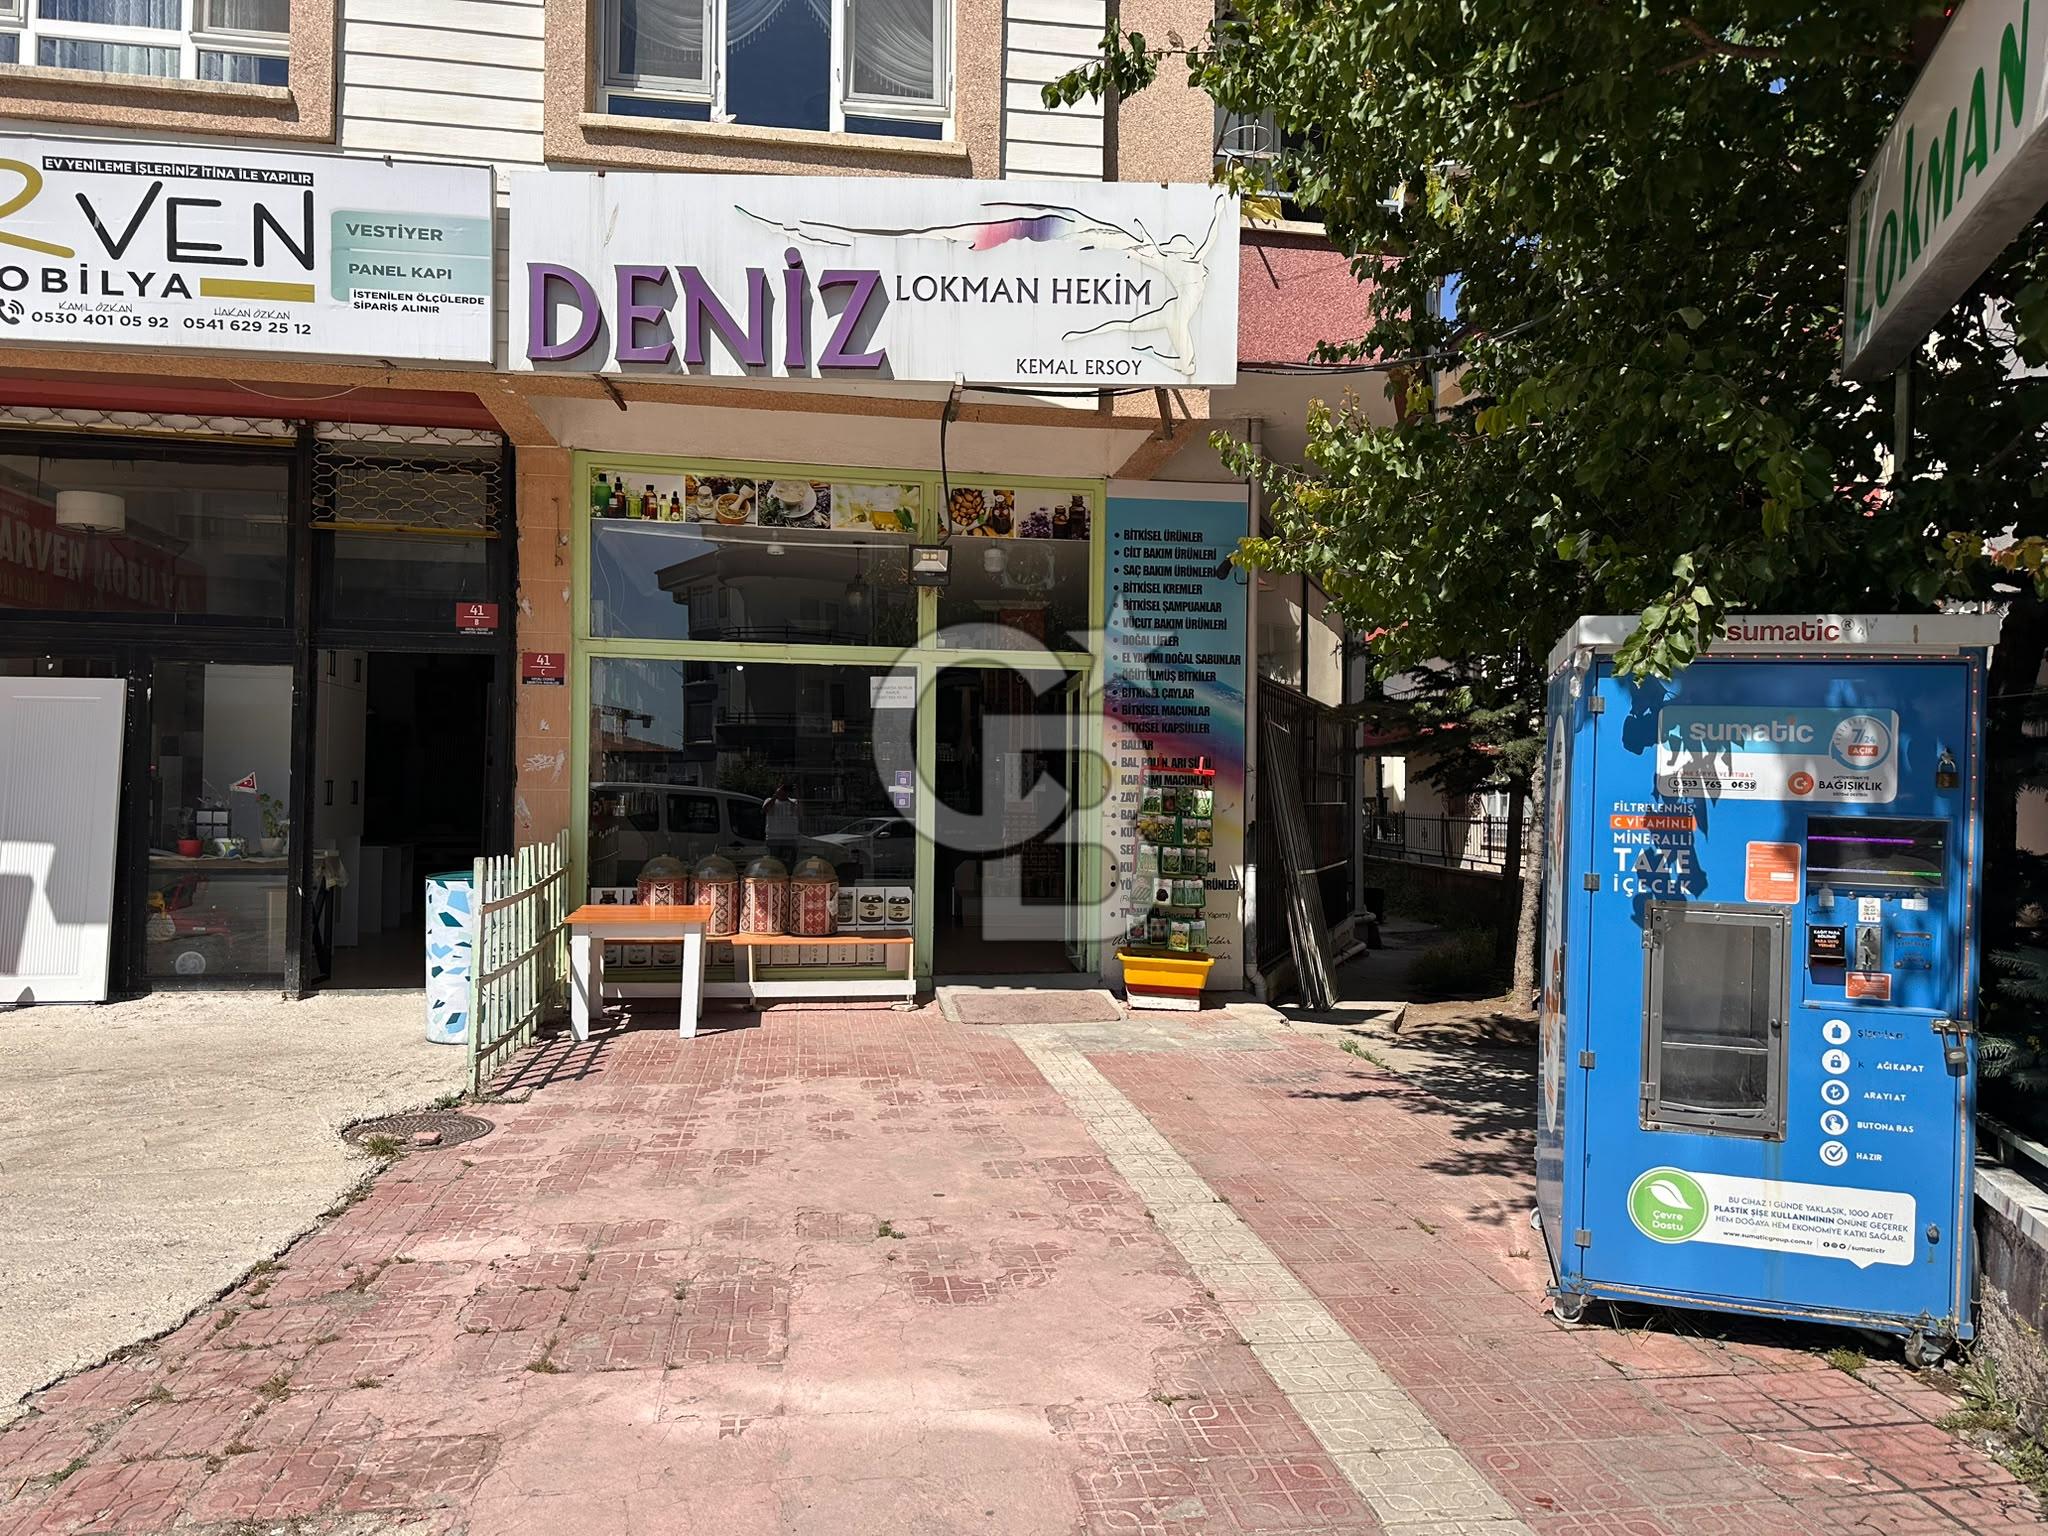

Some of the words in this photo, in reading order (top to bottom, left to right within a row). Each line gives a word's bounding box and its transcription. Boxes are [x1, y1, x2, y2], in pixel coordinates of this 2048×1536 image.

[45, 158, 63, 169] EV
[65, 159, 132, 173] YENİLEME
[135, 161, 198, 177] İŞLERİNİZ
[201, 166, 236, 179] İTİNA
[238, 168, 259, 181] İLE
[261, 171, 312, 184] YAPILIR
[1853, 0, 2030, 341] LOKMAN
[345, 223, 443, 241] VESTİYER
[348, 263, 407, 278] PANEL
[411, 267, 452, 280] KAPI
[896, 274, 1040, 305] LOKMAN
[1052, 271, 1152, 306] HEKİM
[353, 289, 413, 302] İSTENİLEN
[416, 292, 485, 305] ÖLÇÜLERDE
[95, 300, 133, 313] ÖZKAN
[213, 307, 251, 318] HAKAN
[253, 307, 291, 320] ÖZKAN
[353, 300, 398, 313] SİPARİŞ
[401, 303, 440, 314] ALINIR
[526, 247, 888, 373] DENİZ
[32, 311, 77, 324] 0530
[83, 313, 114, 325] 401
[120, 315, 142, 327] 05
[148, 316, 169, 328] 92
[183, 317, 224, 330] 0541
[230, 320, 262, 332] 629
[268, 322, 288, 333] 25
[294, 323, 312, 335] 12
[1015, 357, 1079, 376] KEMAL
[1084, 358, 1143, 376] ERSOY
[1123, 528, 1162, 542] BİTKİSEL
[1164, 529, 1203, 543] ÜRÜNLER
[1123, 545, 1142, 558] CİLT
[1143, 548, 1173, 559] BAKIM
[1174, 547, 1217, 560] ÜRÜNLERİ
[1123, 565, 1142, 577] SAÇ
[1143, 566, 1173, 577] BAKIM
[1174, 564, 1217, 577] ÜRÜNLERİ
[1122, 581, 1161, 594] BİTKİSEL
[1163, 583, 1203, 595] KREMLER
[469, 604, 484, 616] 41
[1122, 598, 1161, 611] BİTKİSEL
[1162, 600, 1222, 614] ŞAMPUANLAR
[1122, 616, 1153, 629] VÜCUT
[1154, 618, 1184, 630] BAKIM
[1185, 617, 1227, 630] ÜRÜNLERİ
[1727, 618, 1840, 641] sumatic
[1122, 633, 1152, 646] DOĞAL
[1153, 634, 1179, 647] LİFLER
[536, 654, 551, 666] 41
[1122, 652, 1132, 663] EL
[1133, 652, 1164, 664] YAPIMI
[1165, 652, 1194, 665] DOĞAL
[1195, 653, 1241, 665] SABUNLAR
[540, 668, 546, 676] C
[1178, 670, 1217, 681] BİTKİLER
[1122, 685, 1160, 699] BİTKİSEL
[1162, 688, 1195, 701] ÇAYLAR
[1122, 703, 1160, 715] BİTKİSEL
[1161, 705, 1211, 717] MACUNLAR
[1121, 720, 1160, 733] BİTKİSEL
[1161, 722, 1210, 734] KAPSÜLLER
[1689, 716, 1814, 743] sumatic
[1121, 739, 1154, 750] BALLAR
[1171, 758, 1187, 769] ARI
[1818, 779, 1882, 792] BAĞIŞIKLIK
[1613, 800, 1694, 816] FİLTRELENMİŞ
[1614, 817, 1622, 827] C
[1626, 816, 1691, 829] VİTAMİNLİ
[1613, 829, 1692, 846] MİNERALLİ
[1613, 847, 1691, 874] TAZE
[1205, 879, 1239, 891] RÜNLER
[1613, 873, 1691, 898] İÇECEK
[1857, 1121, 1895, 1132] BUTONA
[1855, 1152, 1883, 1162] HAZIR
[1652, 1209, 1683, 1220] Çevre
[1728, 1196, 1740, 1204] BU
[1773, 1200, 1803, 1211] GÜNDE
[1848, 1209, 1870, 1218] 1000
[1871, 1212, 1894, 1220] ADET
[1652, 1220, 1684, 1231] Dostu
[1713, 1205, 1749, 1215] PLASTİK
[1750, 1207, 1769, 1218] ŞİŞE
[1770, 1211, 1835, 1224] KULLANIMININ
[1869, 1221, 1909, 1232] GEÇEREK
[1715, 1215, 1733, 1223] HEM
[1735, 1215, 1770, 1228] DOĞAYA
[1771, 1222, 1790, 1230] HEM
[1791, 1224, 1842, 1236] EKONOMİYE
[1843, 1229, 1867, 1238] KATKI
